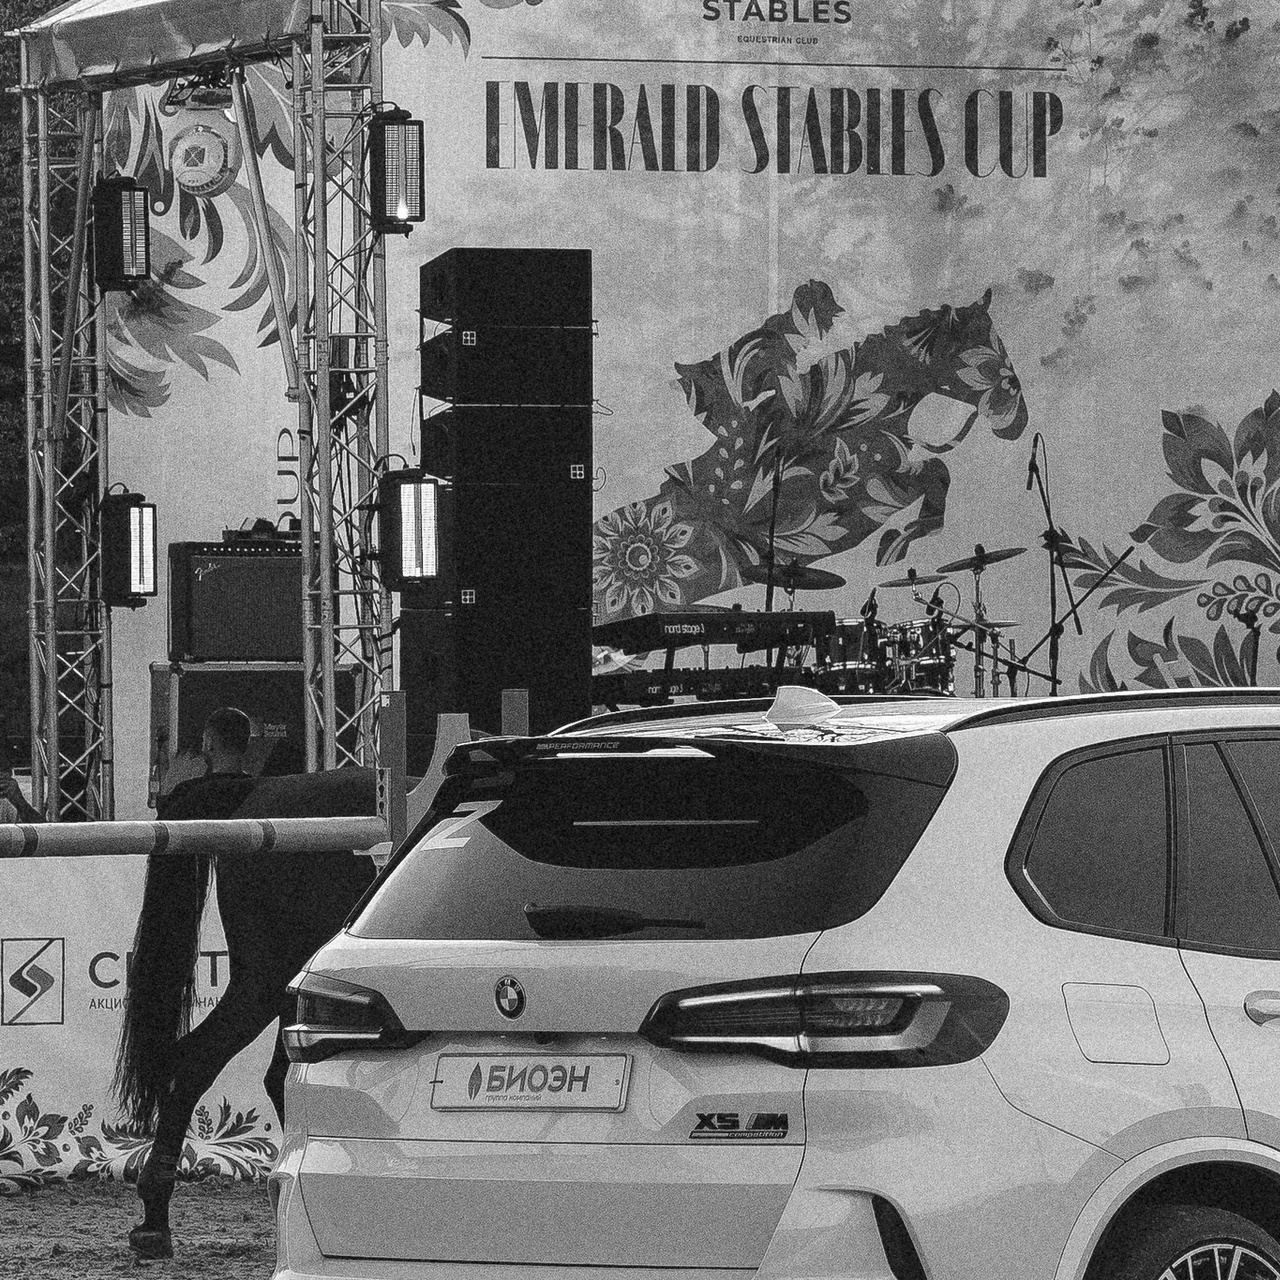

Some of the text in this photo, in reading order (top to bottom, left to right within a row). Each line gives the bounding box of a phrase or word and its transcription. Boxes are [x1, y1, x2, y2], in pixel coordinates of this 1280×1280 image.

[737, 35, 819, 45] EQUESTRIAN CLUB
[485, 80, 1063, 179] EMERALD STABLES CUP
[486, 1064, 591, 1093] БИОЭН
[694, 1112, 740, 1130] X5
[728, 1131, 785, 1139] competition
